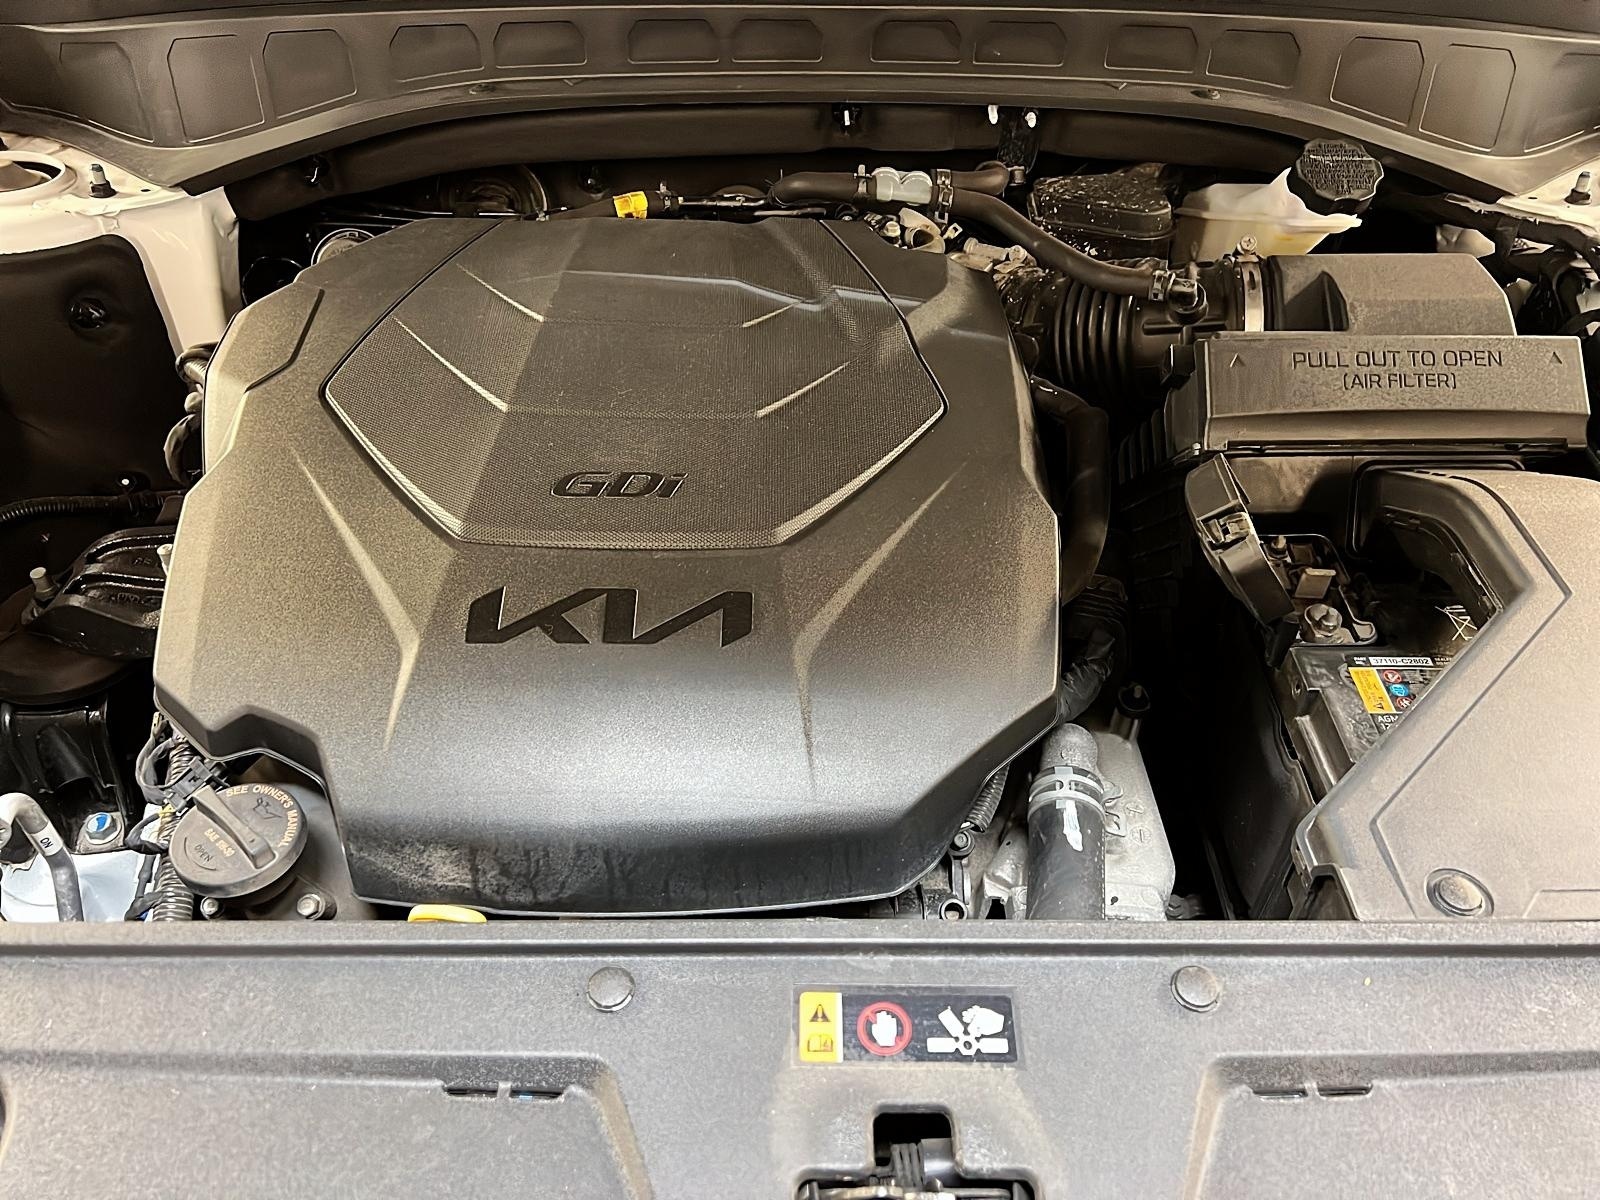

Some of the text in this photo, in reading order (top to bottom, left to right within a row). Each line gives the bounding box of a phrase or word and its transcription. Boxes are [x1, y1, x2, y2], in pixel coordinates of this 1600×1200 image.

[1291, 350, 1503, 369] PULL OUT TO OPEN
[1343, 371, 1457, 390] (AIR FILTER)
[550, 470, 689, 499] GDi
[464, 586, 755, 648] KIA
[1372, 657, 1431, 665] 37110-C2802
[226, 784, 298, 848] SEE OWNER'S MANUAL
[194, 843, 215, 862] OPEN
